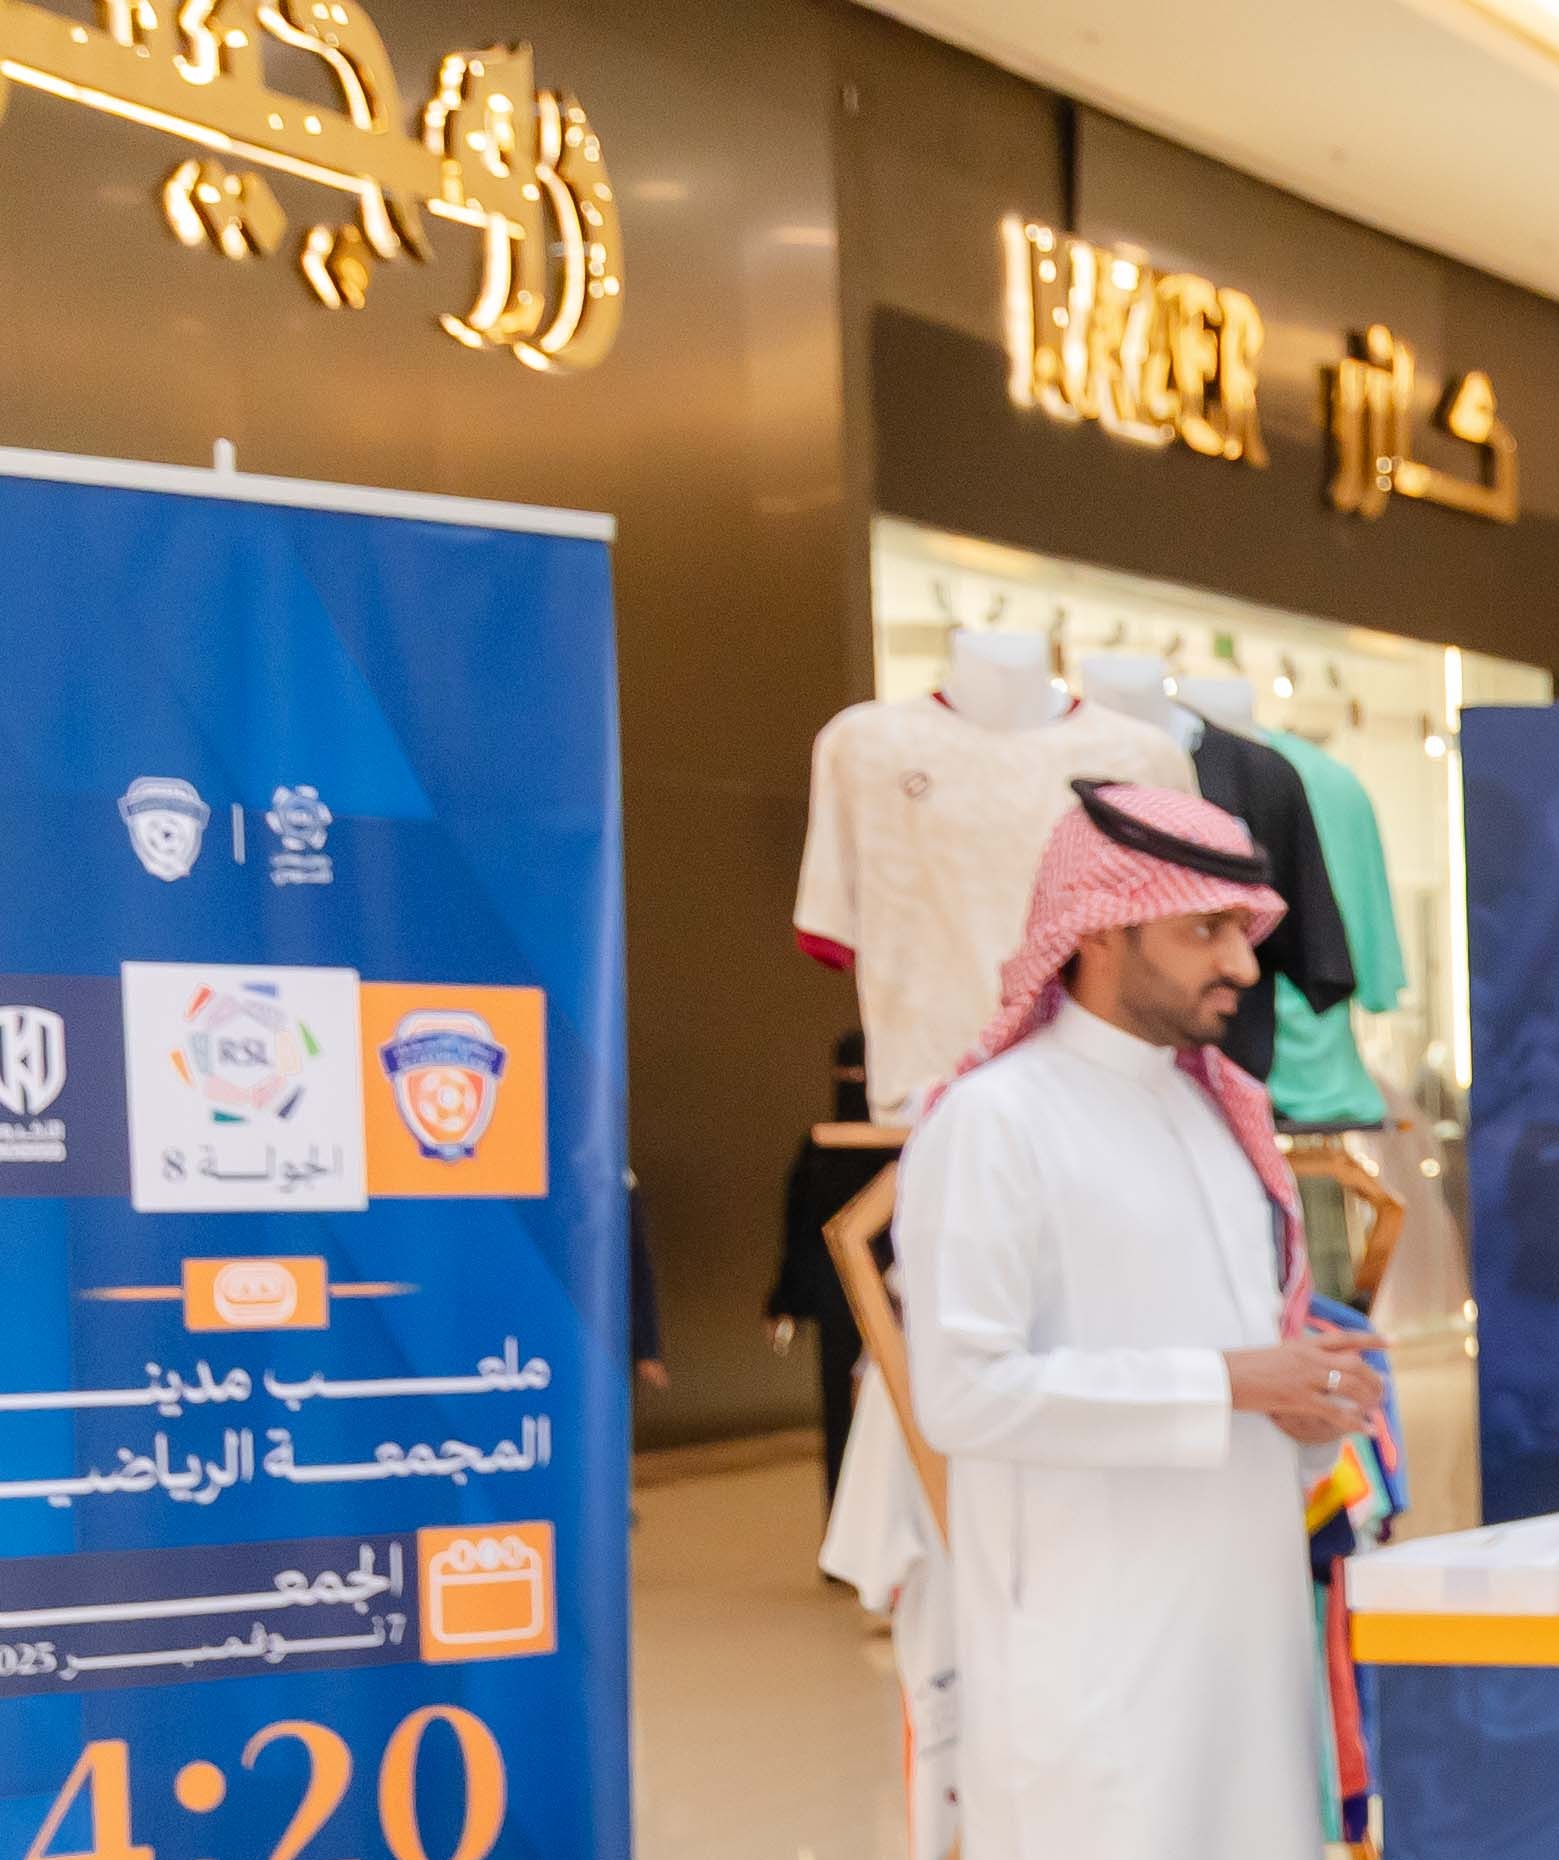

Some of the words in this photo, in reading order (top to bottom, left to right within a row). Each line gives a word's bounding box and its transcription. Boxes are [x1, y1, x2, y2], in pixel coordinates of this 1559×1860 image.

[0, 1361, 253, 1417] مدين
[264, 1335, 551, 1411] ملعب
[0, 1427, 254, 1508] الرياضي
[264, 1414, 551, 1487] المجمعة
[0, 1542, 404, 1629] الجمع
[0, 1641, 56, 1678] 025
